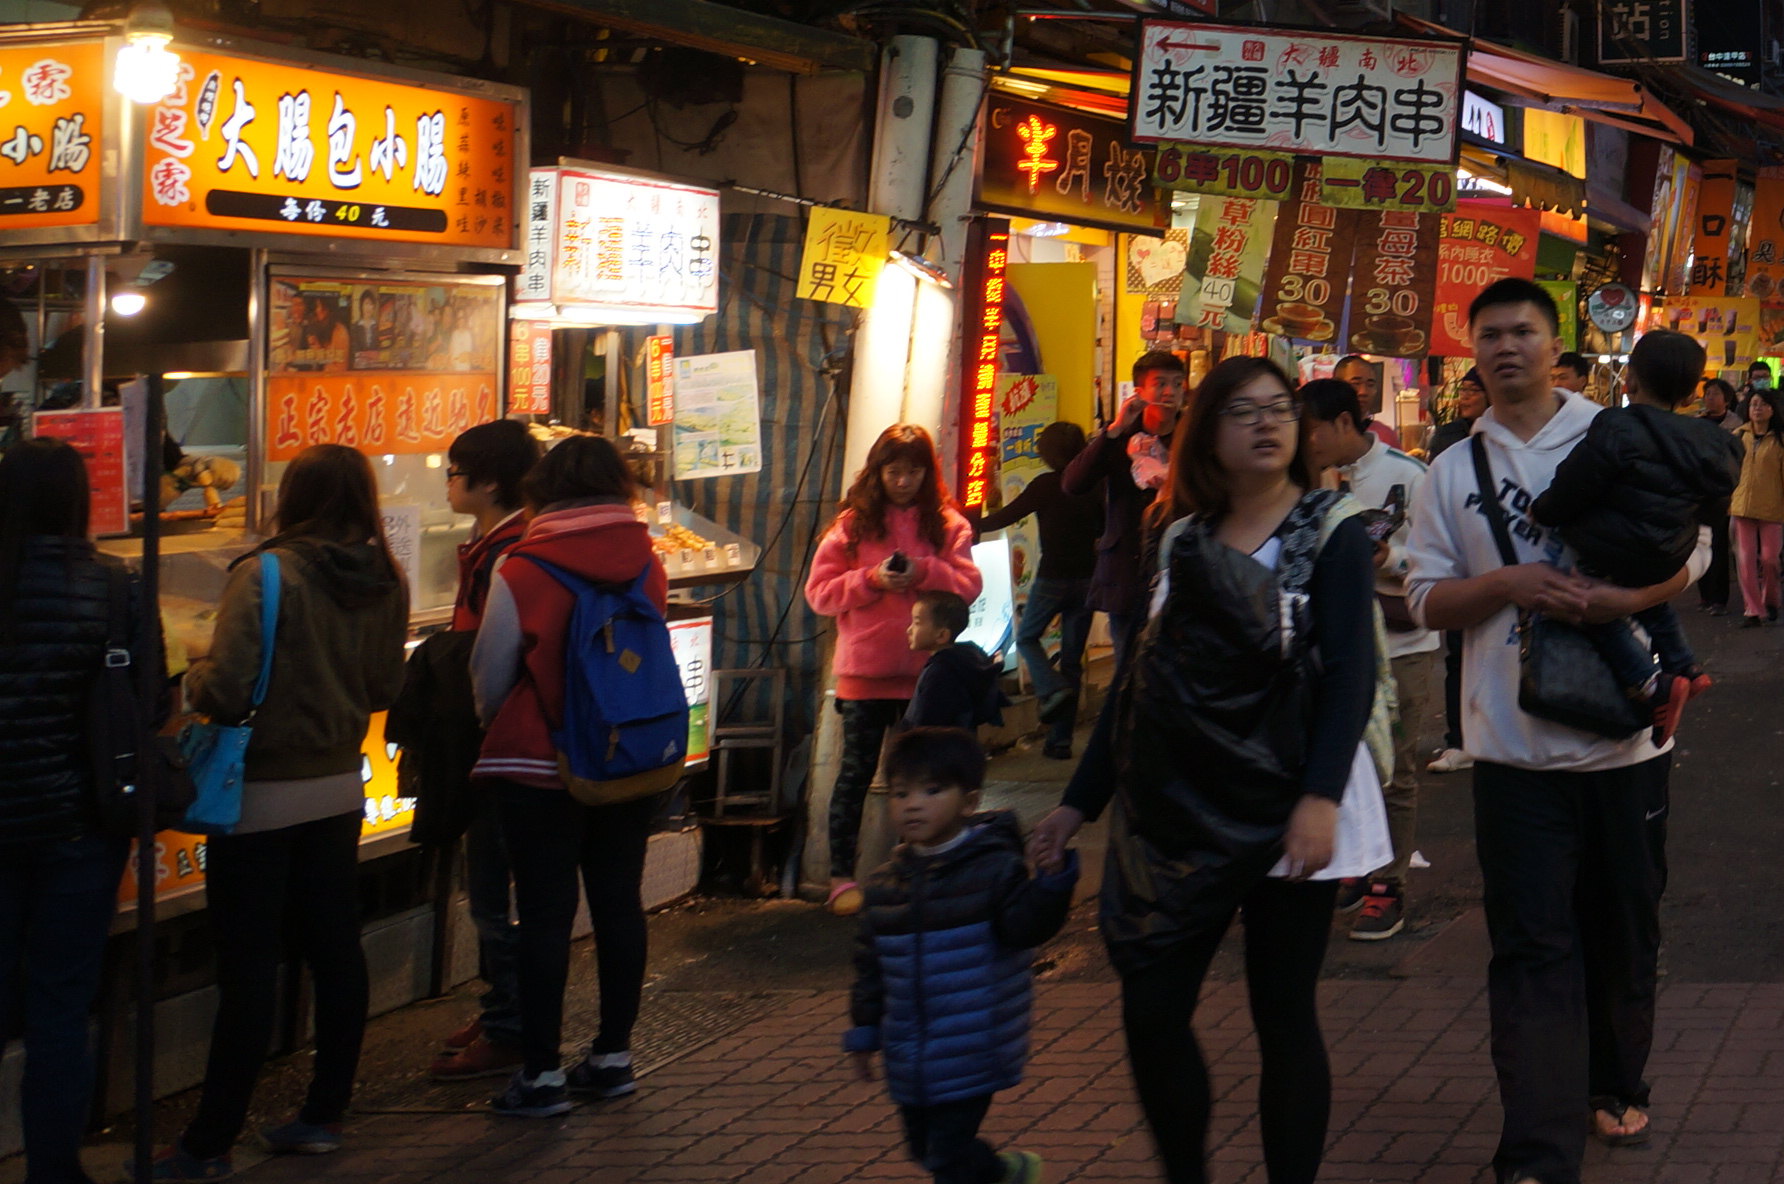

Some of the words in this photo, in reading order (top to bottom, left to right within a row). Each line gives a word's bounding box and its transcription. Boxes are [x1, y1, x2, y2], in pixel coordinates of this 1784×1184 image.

[1282, 41, 1418, 74] 大疆南北
[1145, 58, 1445, 149] 新疆羊肉串
[217, 75, 449, 197] 大腸包小腸
[1158, 150, 1290, 194] 6串100
[1324, 166, 1453, 207] 一律20
[334, 204, 362, 223] 40
[370, 206, 390, 228] 元
[528, 176, 551, 294] 新疆羊肉串
[1692, 171, 1734, 290] 一口酥
[809, 261, 873, 308] 男女
[1203, 280, 1232, 303] 40
[1280, 276, 1329, 306] 30
[1364, 287, 1420, 316] 30
[1199, 305, 1225, 329] 元
